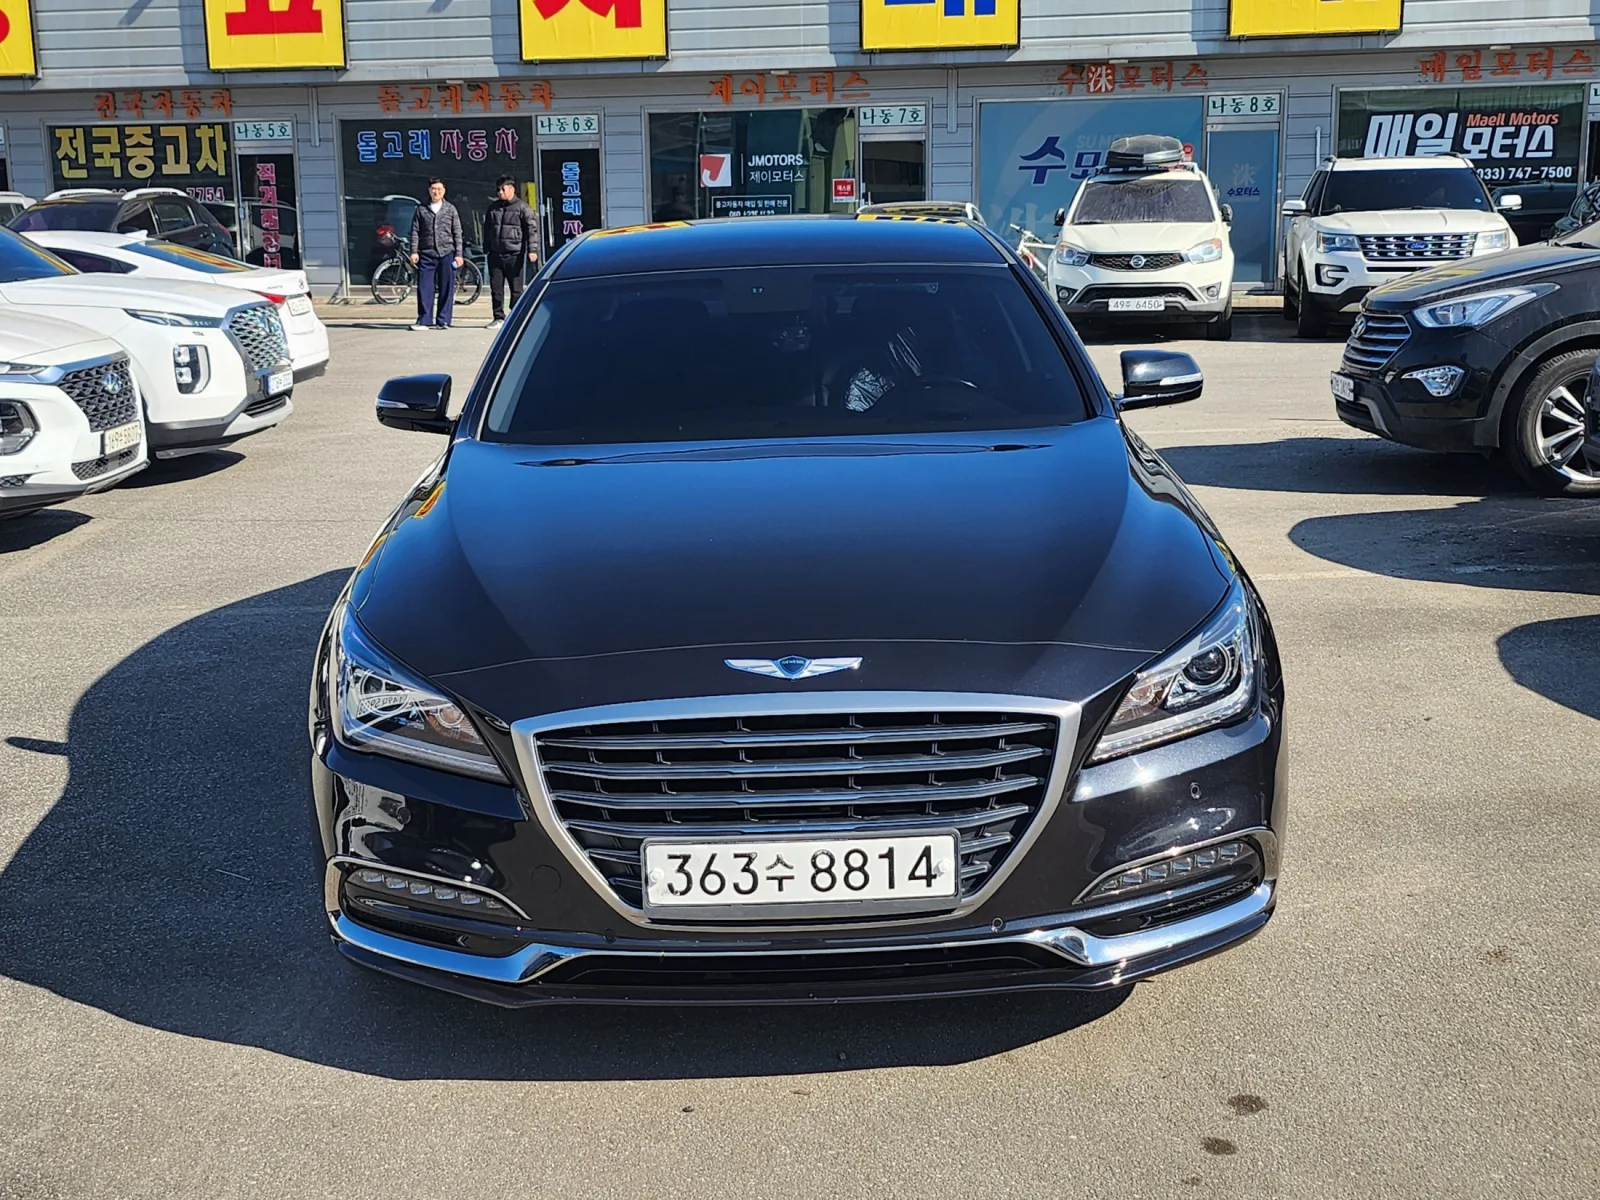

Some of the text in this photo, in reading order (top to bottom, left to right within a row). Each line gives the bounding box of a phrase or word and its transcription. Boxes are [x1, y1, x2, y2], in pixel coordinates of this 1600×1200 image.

[1419, 48, 1593, 82] 매일모터스
[377, 81, 556, 113] 돌고래자동차
[708, 71, 870, 105] 제이모터스
[94, 89, 235, 119] 전국자동차
[1466, 112, 1559, 127] Maeil Motors
[357, 127, 519, 162] 돌고래 자동차
[1363, 112, 1554, 160] 매일 모터스
[55, 125, 227, 179] 전국중고차
[748, 153, 804, 167] JMOTORS
[749, 170, 805, 183] 제이모터스
[1508, 166, 1572, 179] 747-7500
[561, 162, 582, 216] 돌고래
[715, 200, 743, 208] 중고자동차
[1226, 187, 1260, 197] 수모터스
